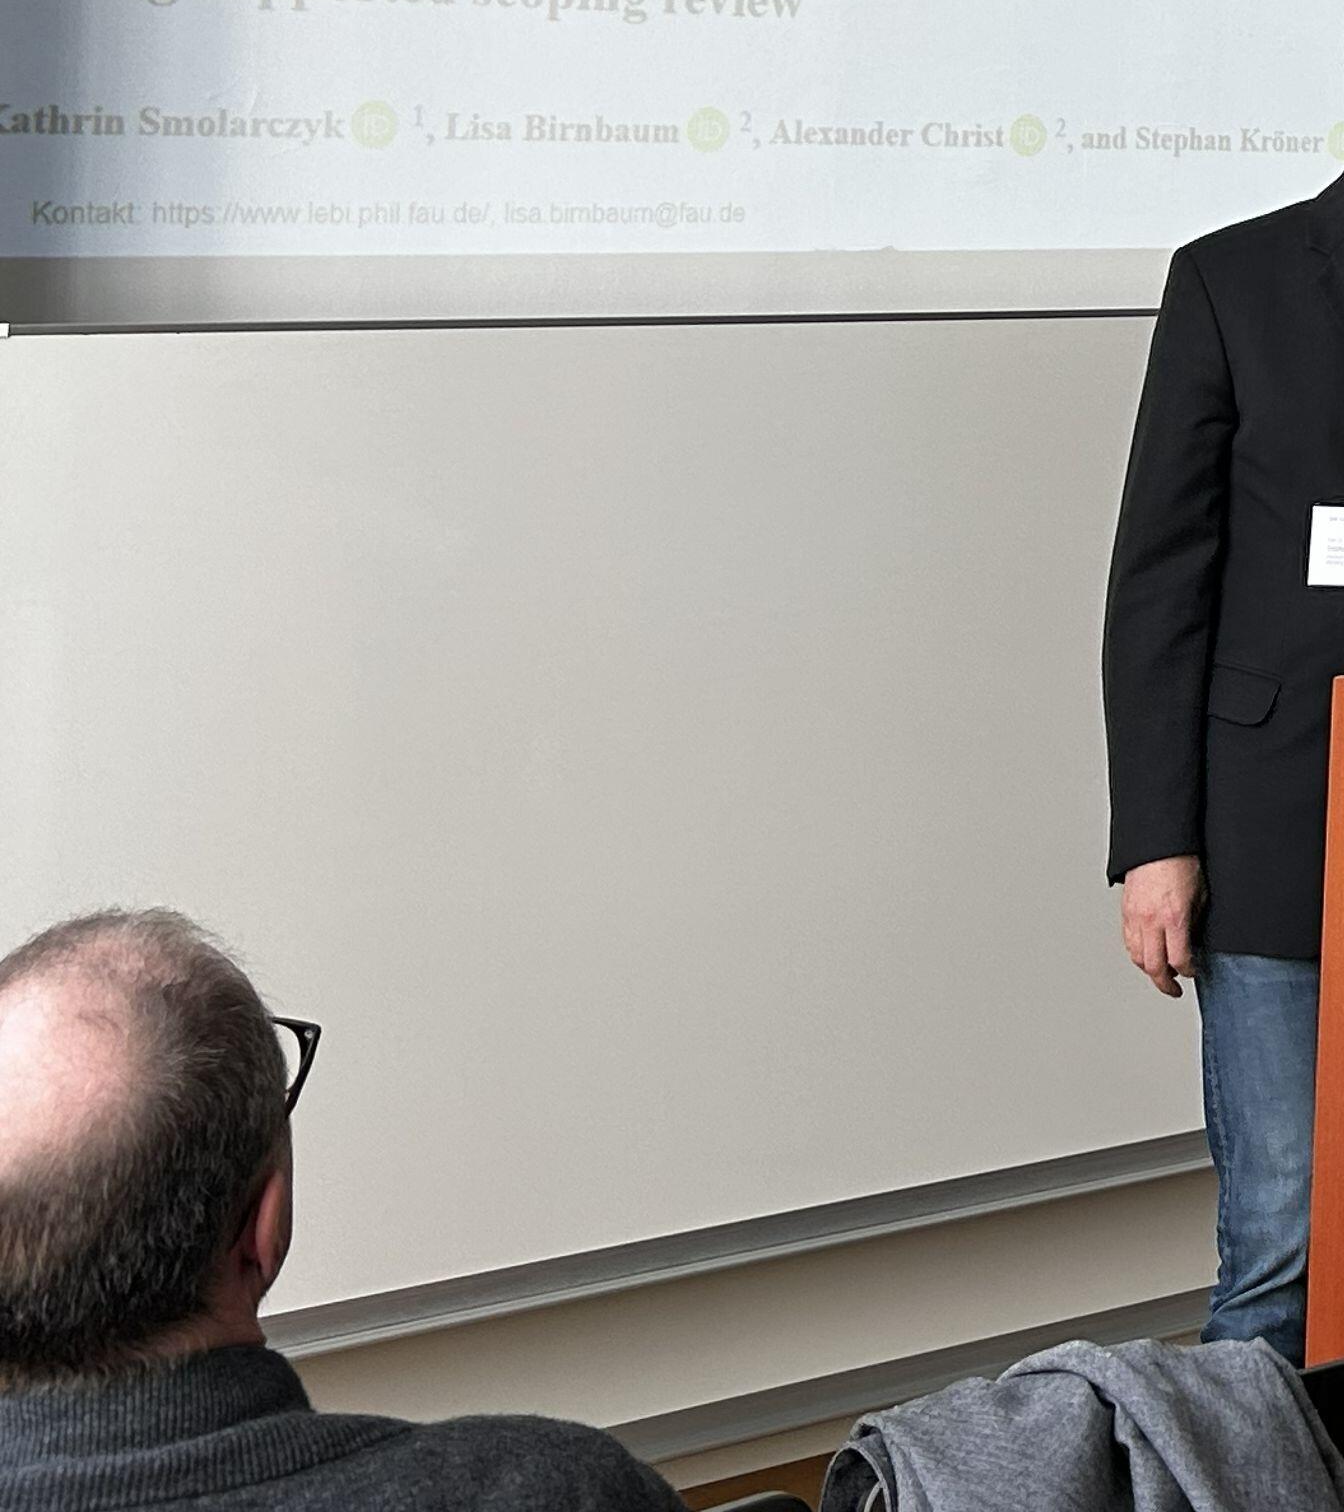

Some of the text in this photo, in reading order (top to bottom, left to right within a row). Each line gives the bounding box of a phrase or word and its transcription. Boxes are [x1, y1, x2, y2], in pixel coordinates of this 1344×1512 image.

[139, 105, 344, 147] Smolarczyk
[444, 112, 512, 143] Lisa
[523, 113, 681, 145] Birnbaum
[770, 117, 913, 149] Alexander
[922, 120, 1004, 150] Christ
[1135, 126, 1233, 157] Stephan
[1240, 128, 1324, 153] Kröner
